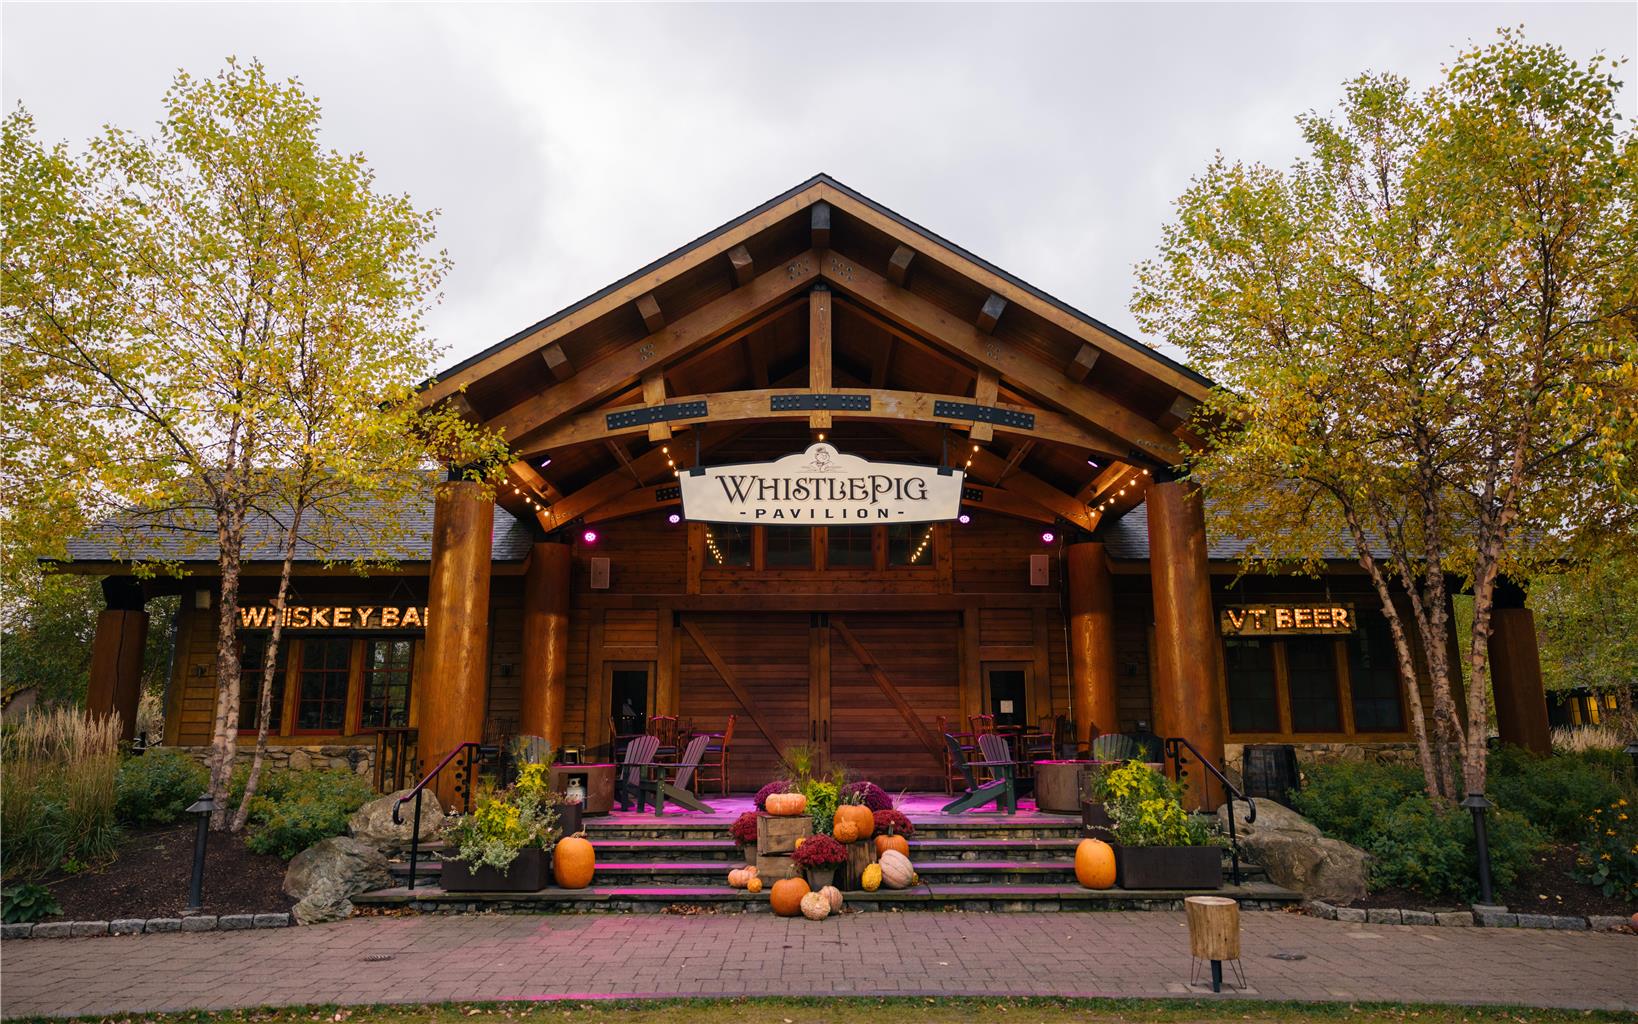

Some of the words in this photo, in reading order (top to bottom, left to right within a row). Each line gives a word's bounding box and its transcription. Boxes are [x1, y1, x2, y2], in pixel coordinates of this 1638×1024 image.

[240, 607, 374, 628] WHISKEY
[1227, 609, 1266, 629] VT
[1275, 608, 1350, 628] BEER
